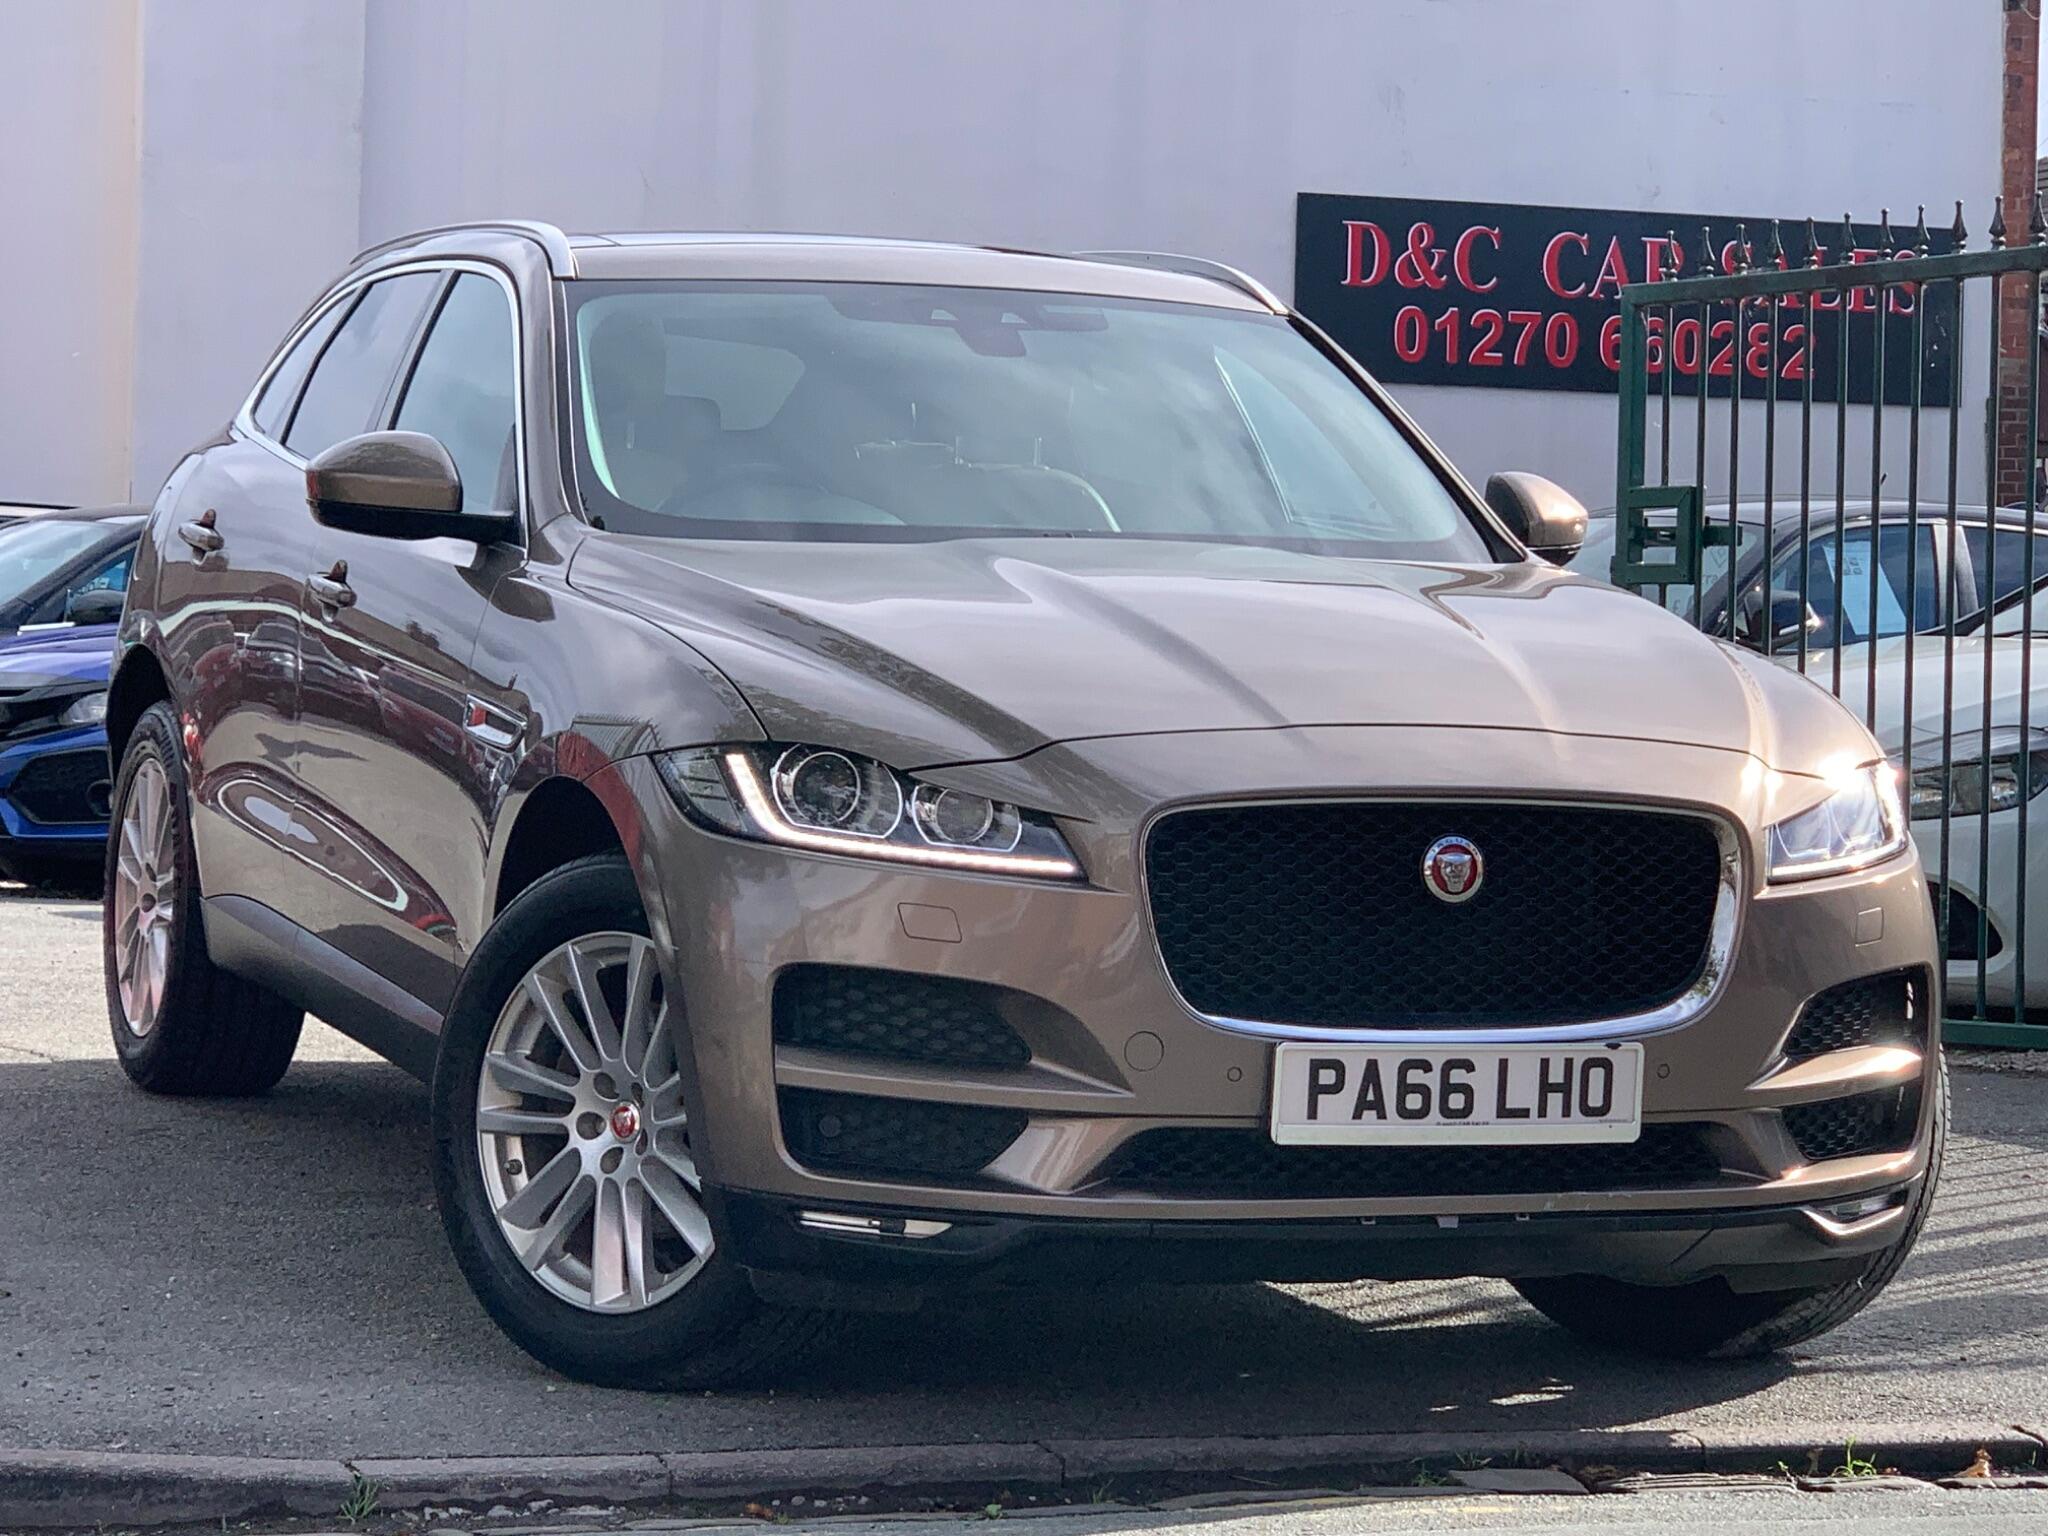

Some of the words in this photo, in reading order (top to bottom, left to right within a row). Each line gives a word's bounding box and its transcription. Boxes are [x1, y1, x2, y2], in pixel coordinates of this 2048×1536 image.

[1341, 220, 1502, 293] D&C
[1394, 305, 1580, 368] 01270
[1600, 314, 1816, 380] 660282
[1430, 837, 1480, 857] JAGUAR
[1306, 1058, 1477, 1121] PA66
[1496, 1057, 1614, 1118] LHO
